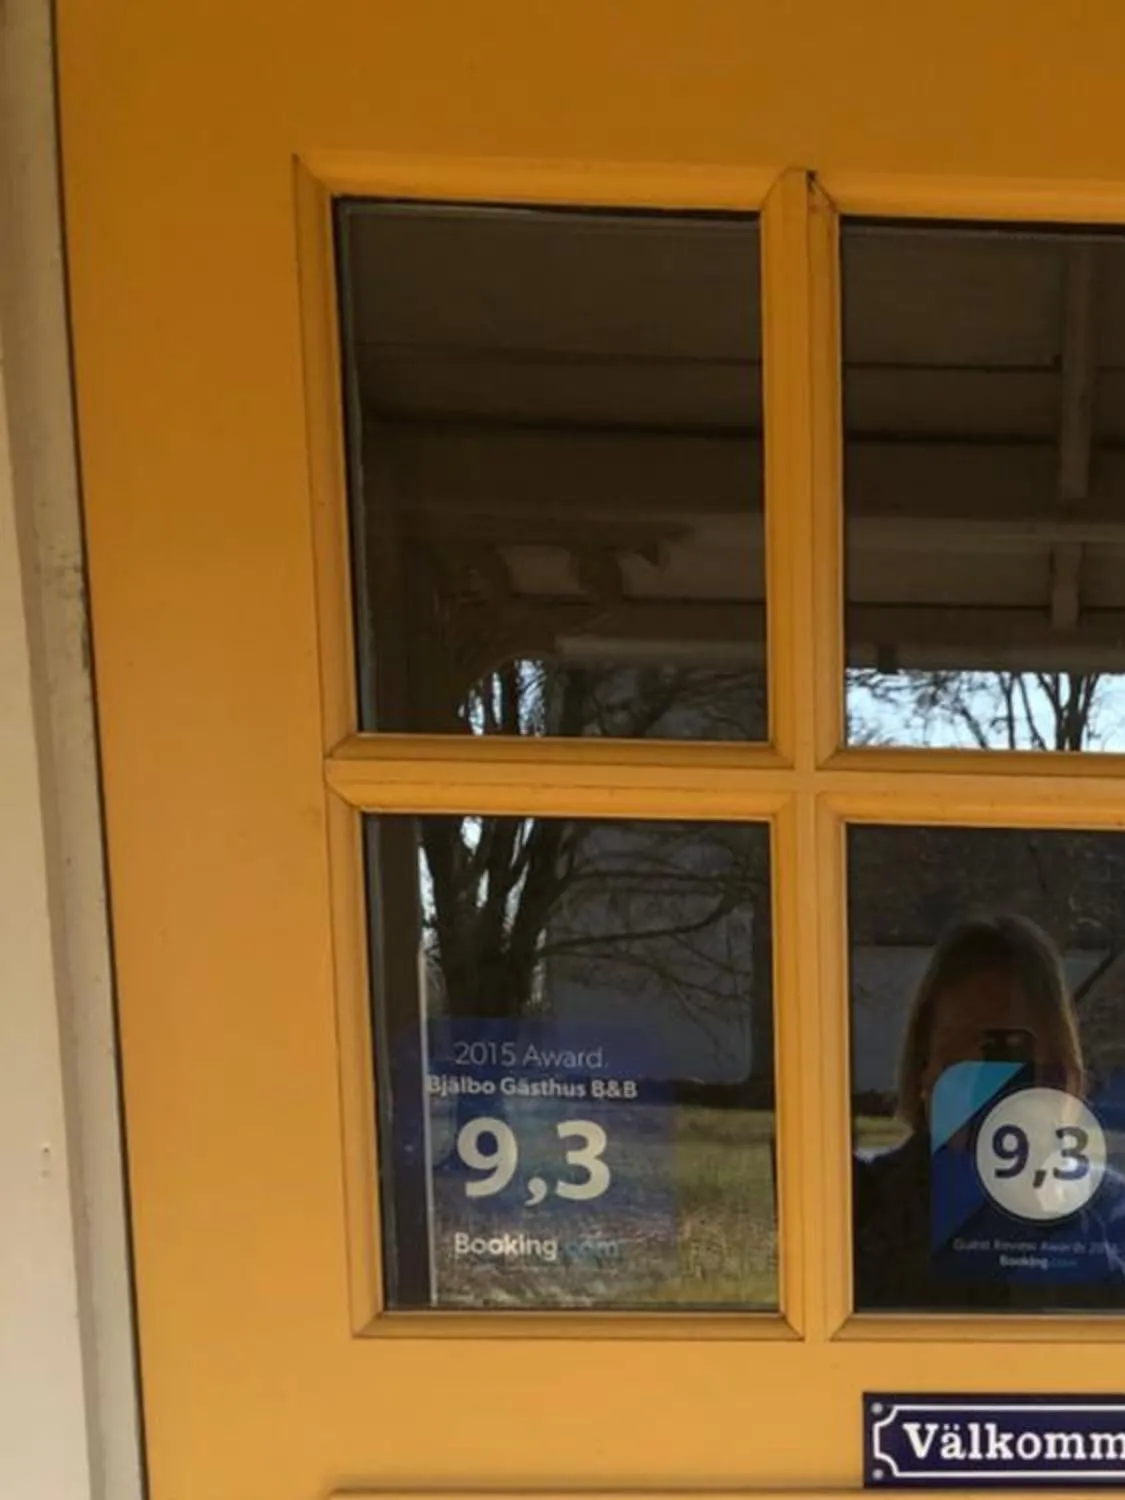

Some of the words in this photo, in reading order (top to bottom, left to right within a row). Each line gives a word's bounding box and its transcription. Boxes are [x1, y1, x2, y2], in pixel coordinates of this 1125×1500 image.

[455, 1041, 516, 1066] 2015
[428, 1075, 496, 1099] Bjälbo
[591, 1080, 637, 1099] B&B
[456, 1117, 611, 1207] 9,3
[991, 1124, 1091, 1188] 9,3
[454, 1232, 620, 1261] Bookingcom
